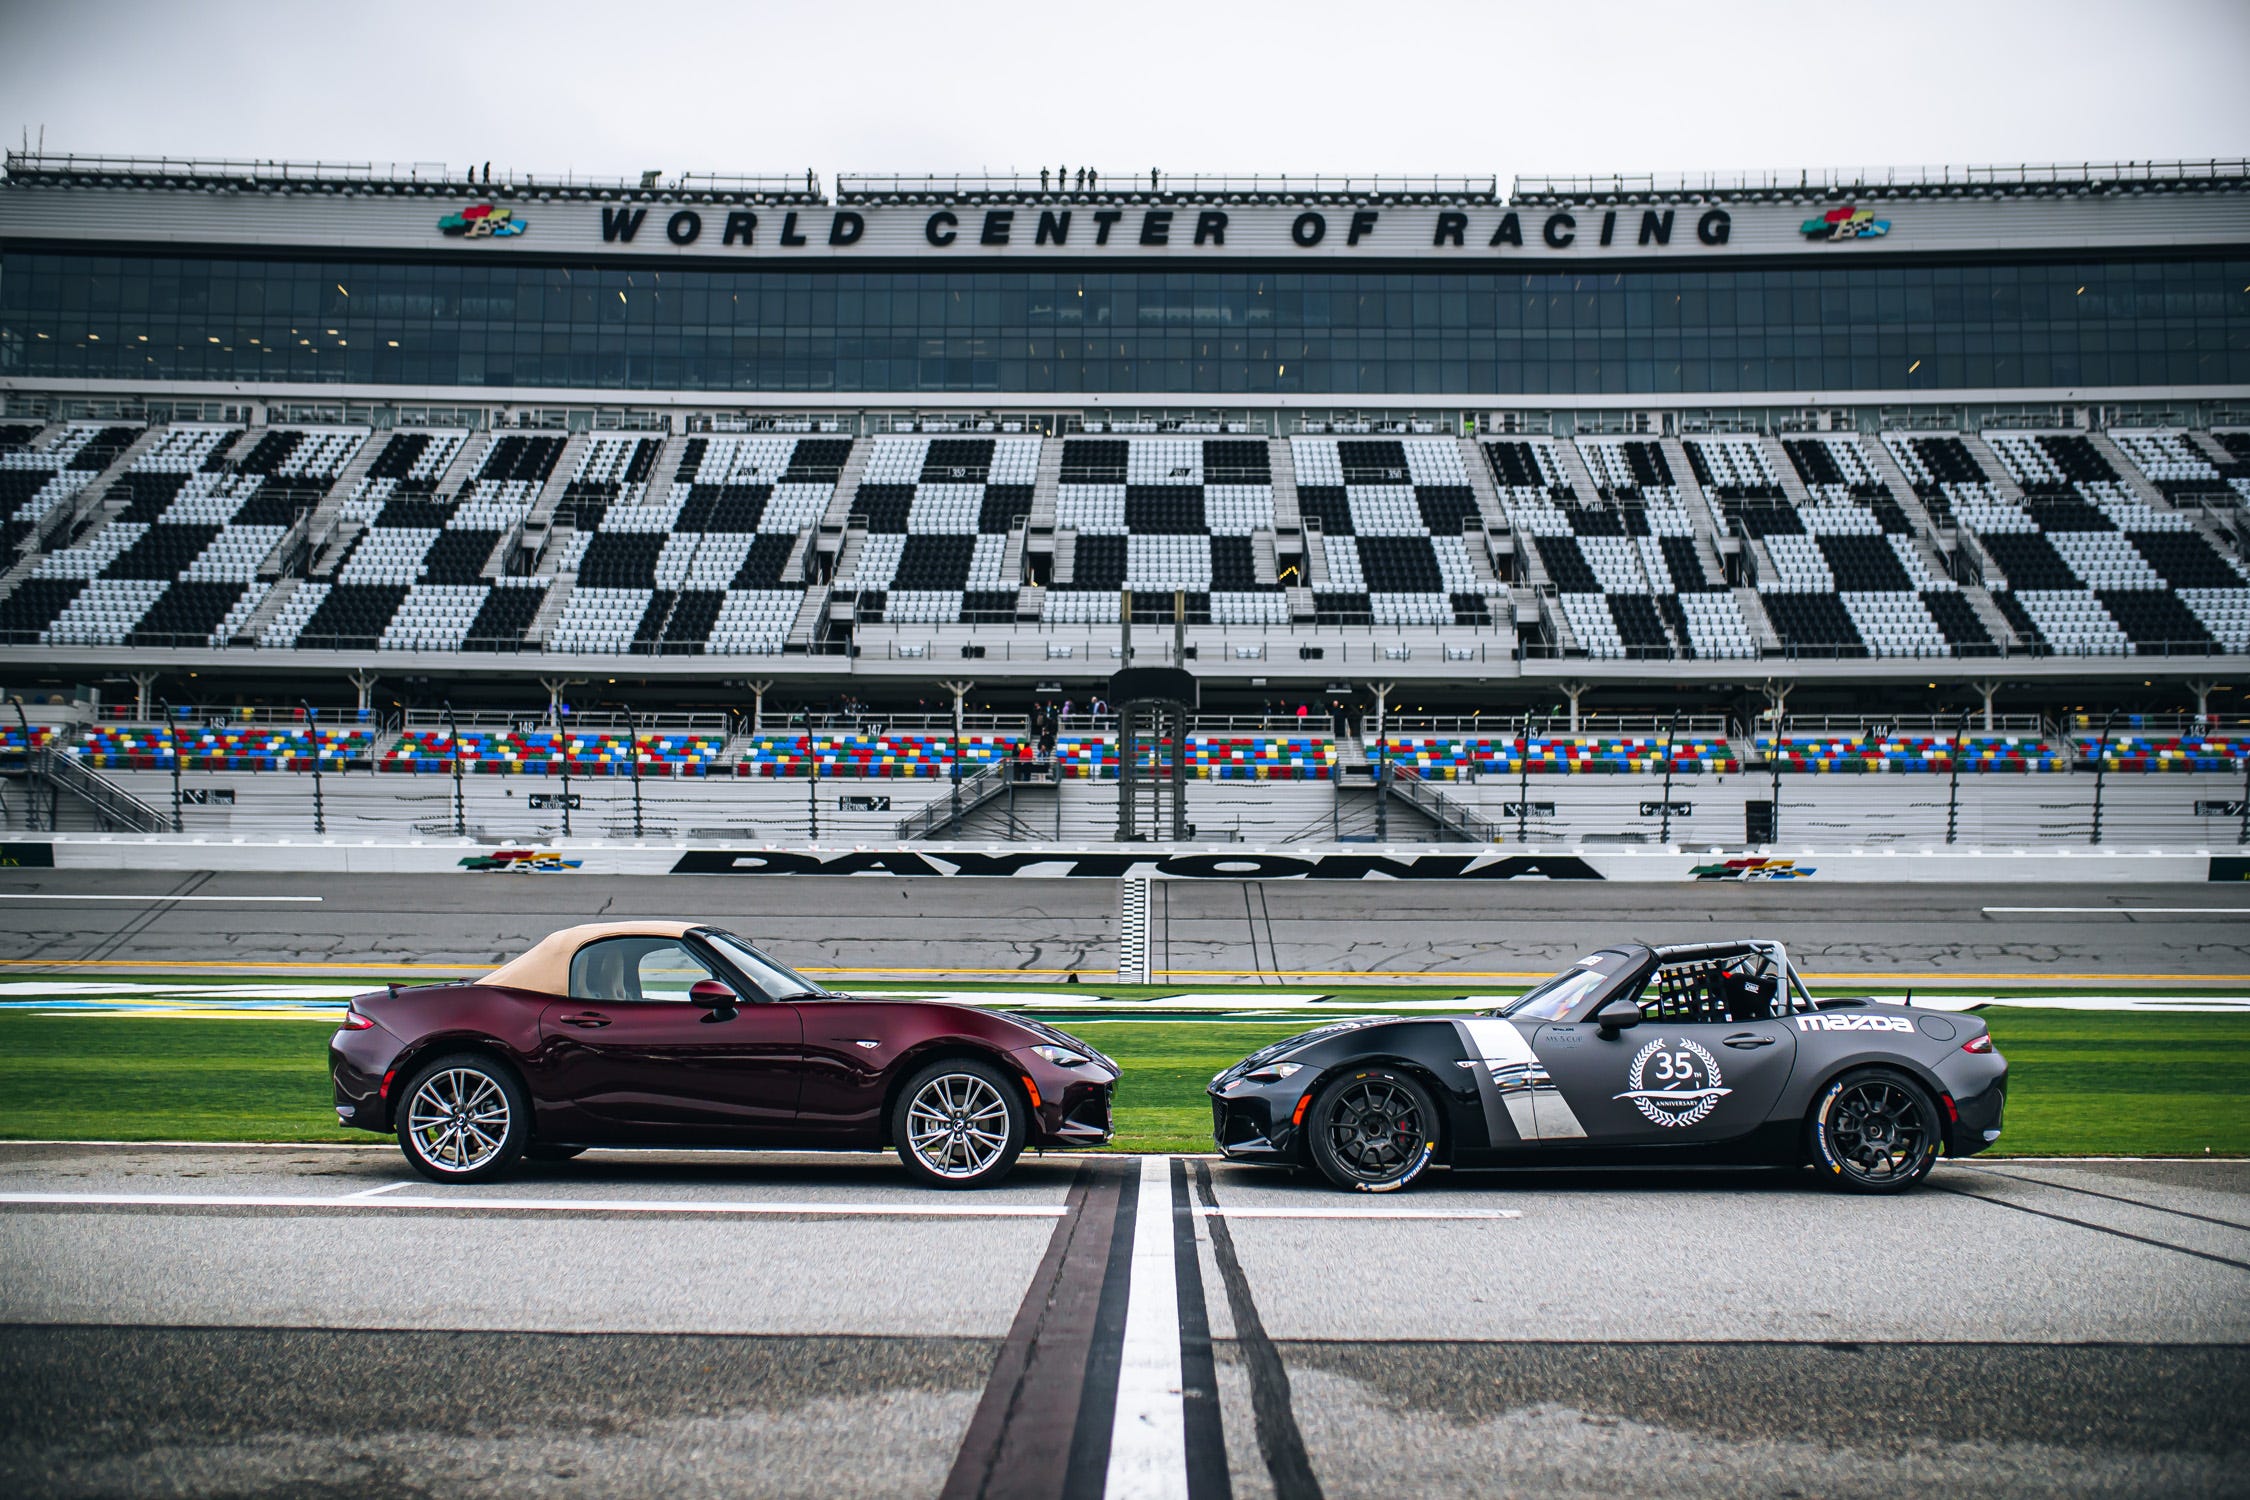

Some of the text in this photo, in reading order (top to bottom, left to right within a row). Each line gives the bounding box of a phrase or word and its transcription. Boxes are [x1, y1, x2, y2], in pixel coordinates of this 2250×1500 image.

[601, 208, 1732, 247] WORLD CENTER OF RACING
[518, 721, 534, 733] 148
[867, 724, 882, 736] 147
[1872, 725, 1888, 738] 144
[842, 803, 868, 811] SECTIONS
[669, 850, 1605, 880] DAYTONA
[1795, 1015, 1915, 1033] mazda
[1402, 1152, 1429, 1184] MICHELIN
